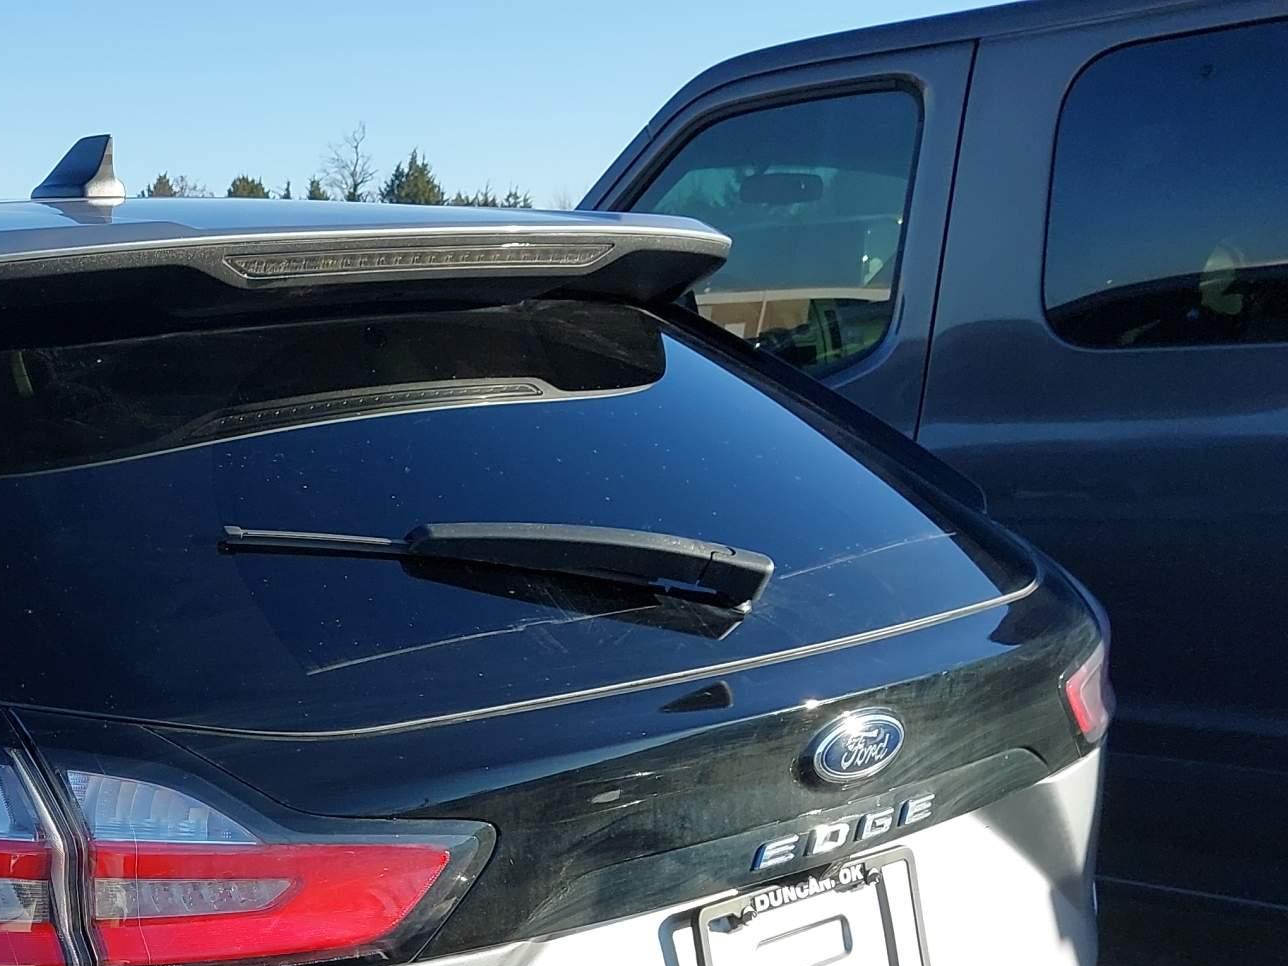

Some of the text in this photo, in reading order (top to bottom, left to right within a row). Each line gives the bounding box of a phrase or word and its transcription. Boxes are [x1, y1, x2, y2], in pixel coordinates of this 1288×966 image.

[840, 728, 890, 770] Ford
[750, 793, 935, 872] EDGE
[754, 865, 865, 912] DUNCAN, OK
